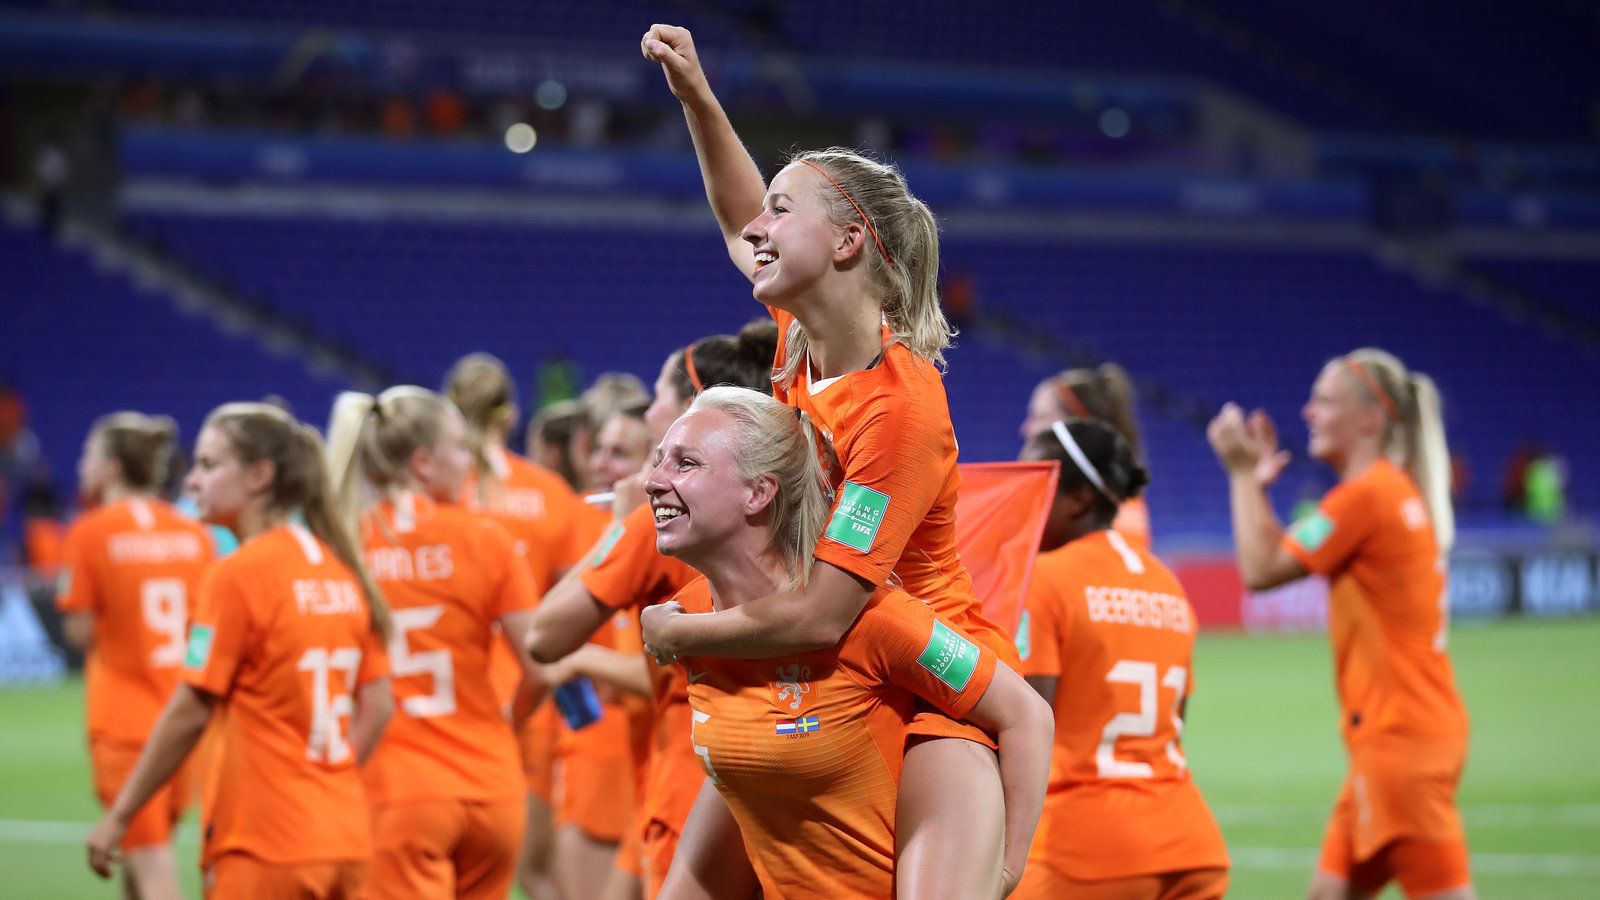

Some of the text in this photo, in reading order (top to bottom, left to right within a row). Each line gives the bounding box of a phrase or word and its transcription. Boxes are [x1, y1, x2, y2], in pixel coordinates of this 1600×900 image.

[840, 504, 876, 523] FOOTBALL
[843, 498, 880, 517] LIVING
[851, 522, 873, 536] FIFA
[140, 578, 187, 667] 9
[388, 605, 457, 718] 5
[931, 631, 952, 669] LIVING
[936, 634, 957, 673] FOOTBALL
